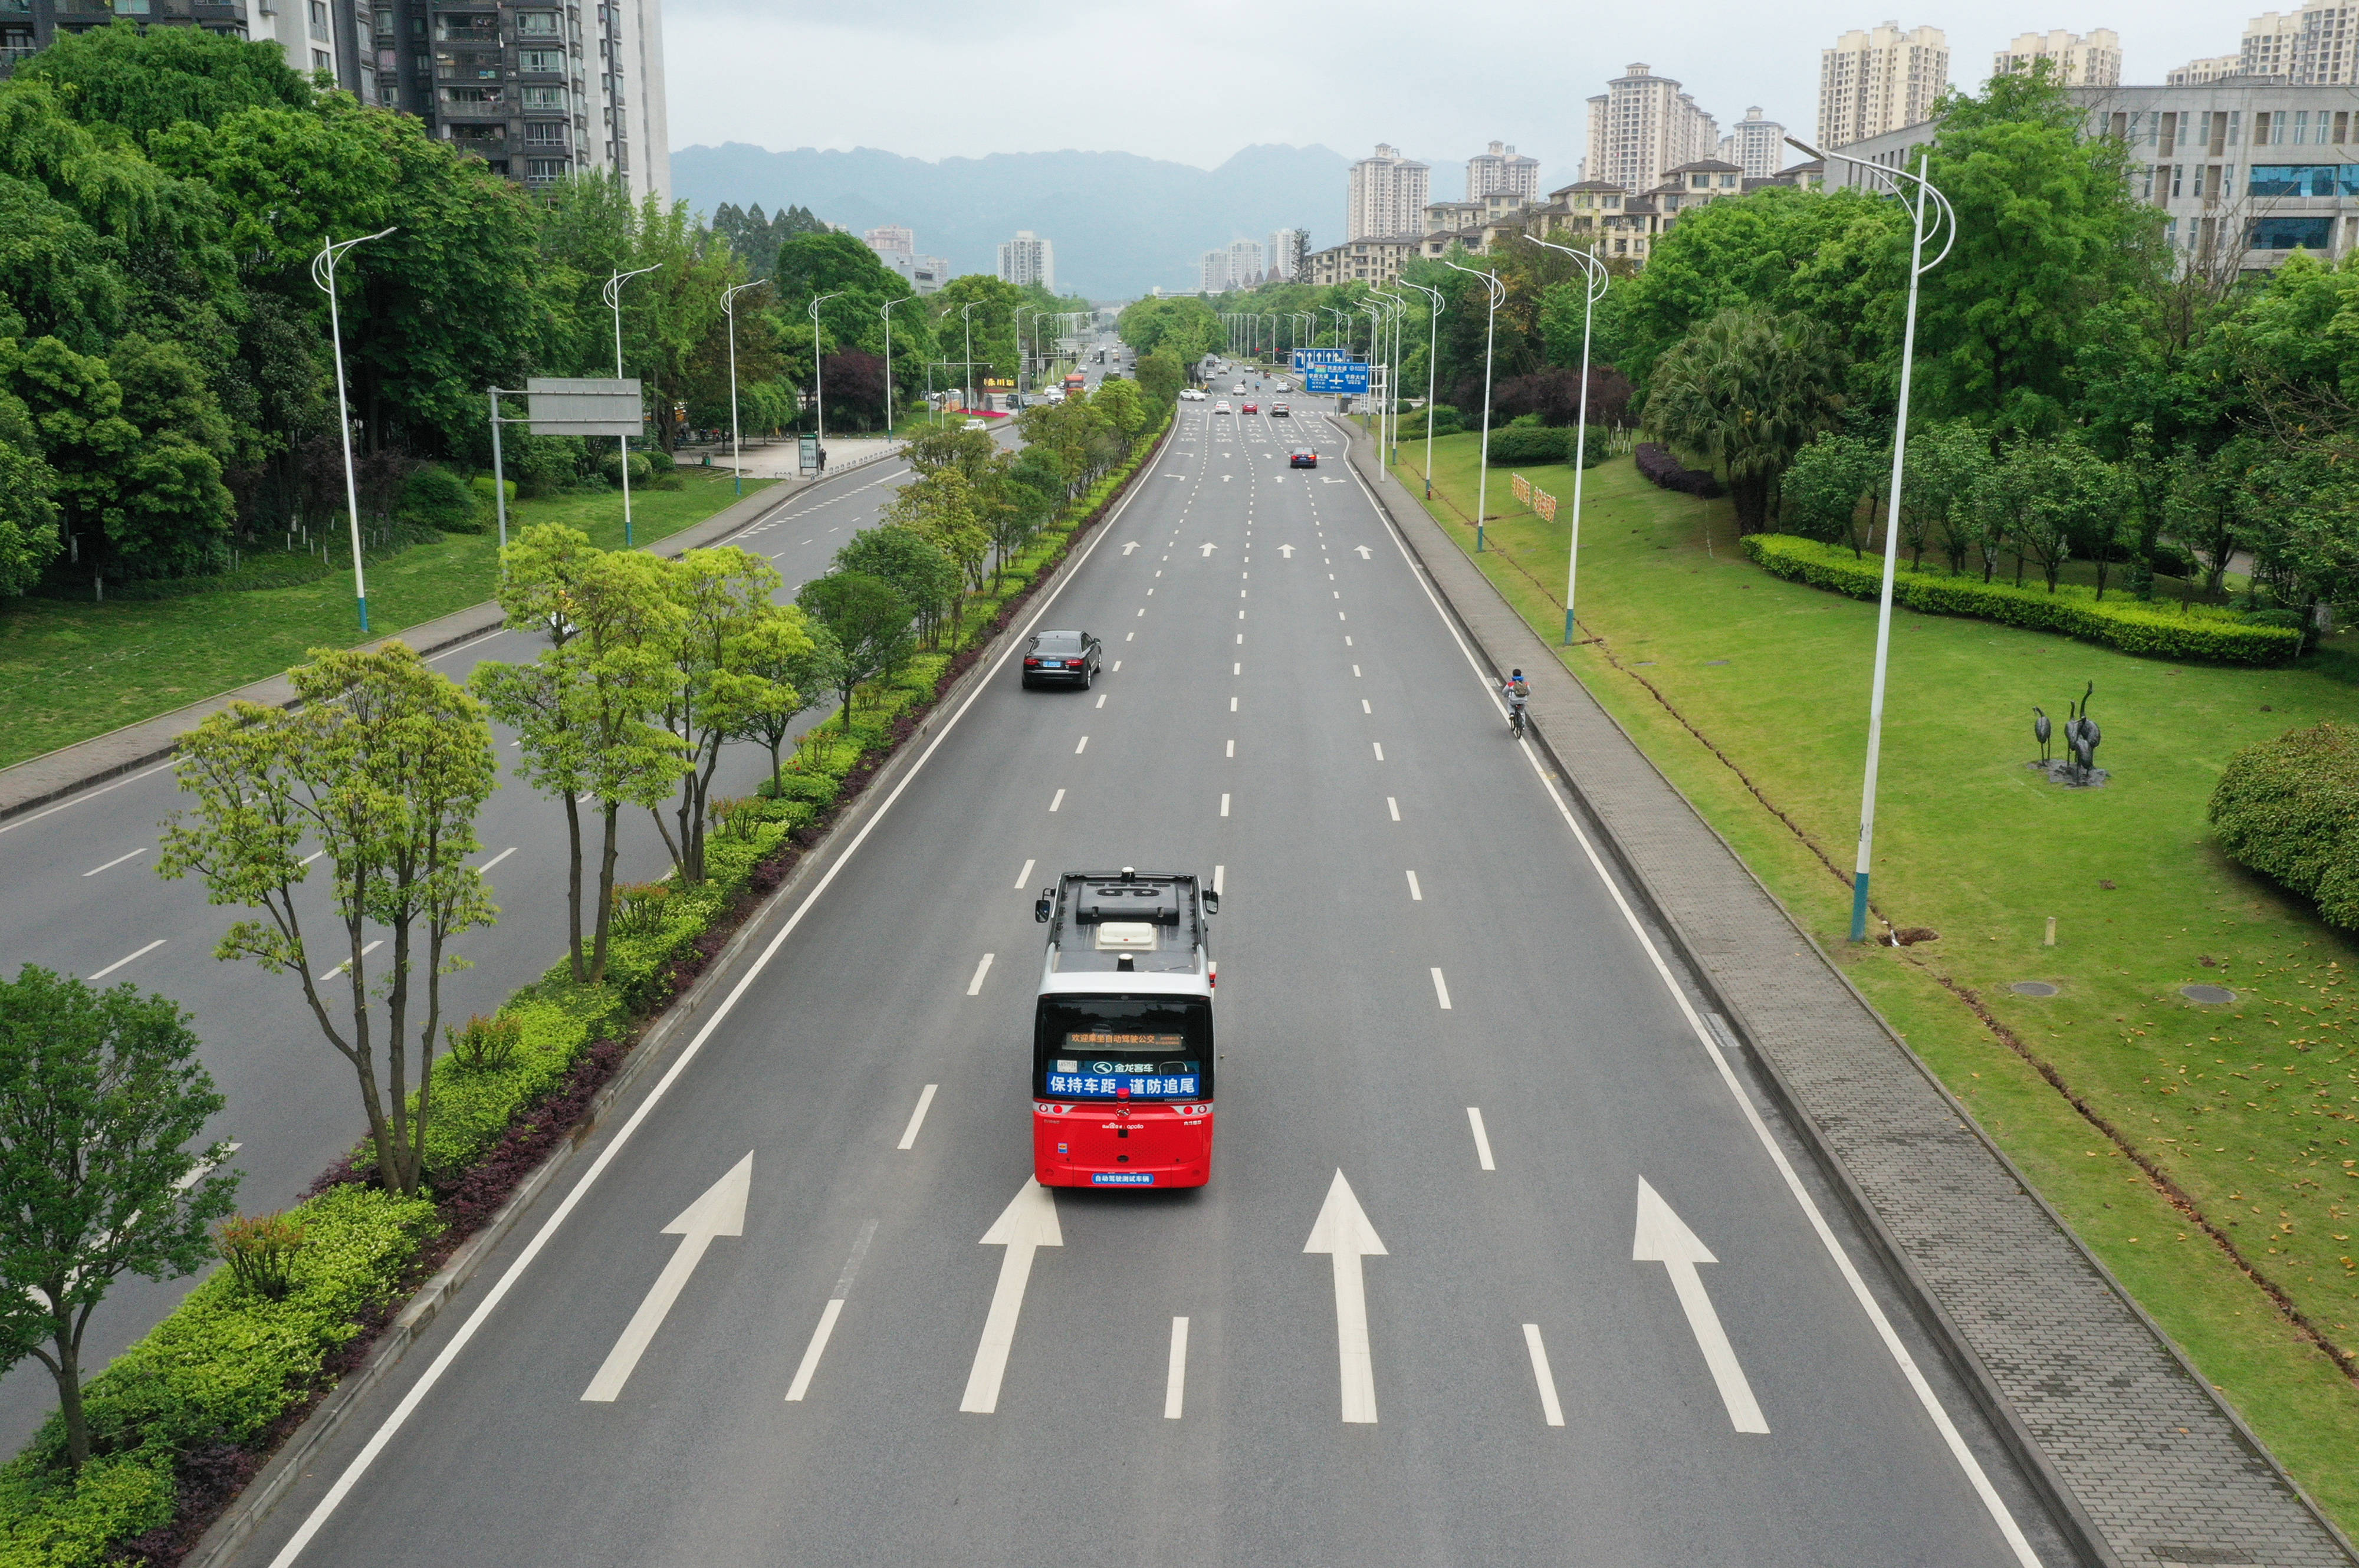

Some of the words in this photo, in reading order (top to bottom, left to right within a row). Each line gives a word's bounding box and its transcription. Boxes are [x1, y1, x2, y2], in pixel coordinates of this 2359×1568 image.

[1071, 1033, 1155, 1044] 欢迎乘坐自动驾驶公交
[1114, 1063, 1154, 1073] 金龙客车
[1050, 1076, 1116, 1094] 保持车距
[1129, 1077, 1195, 1094] 谨防追尾
